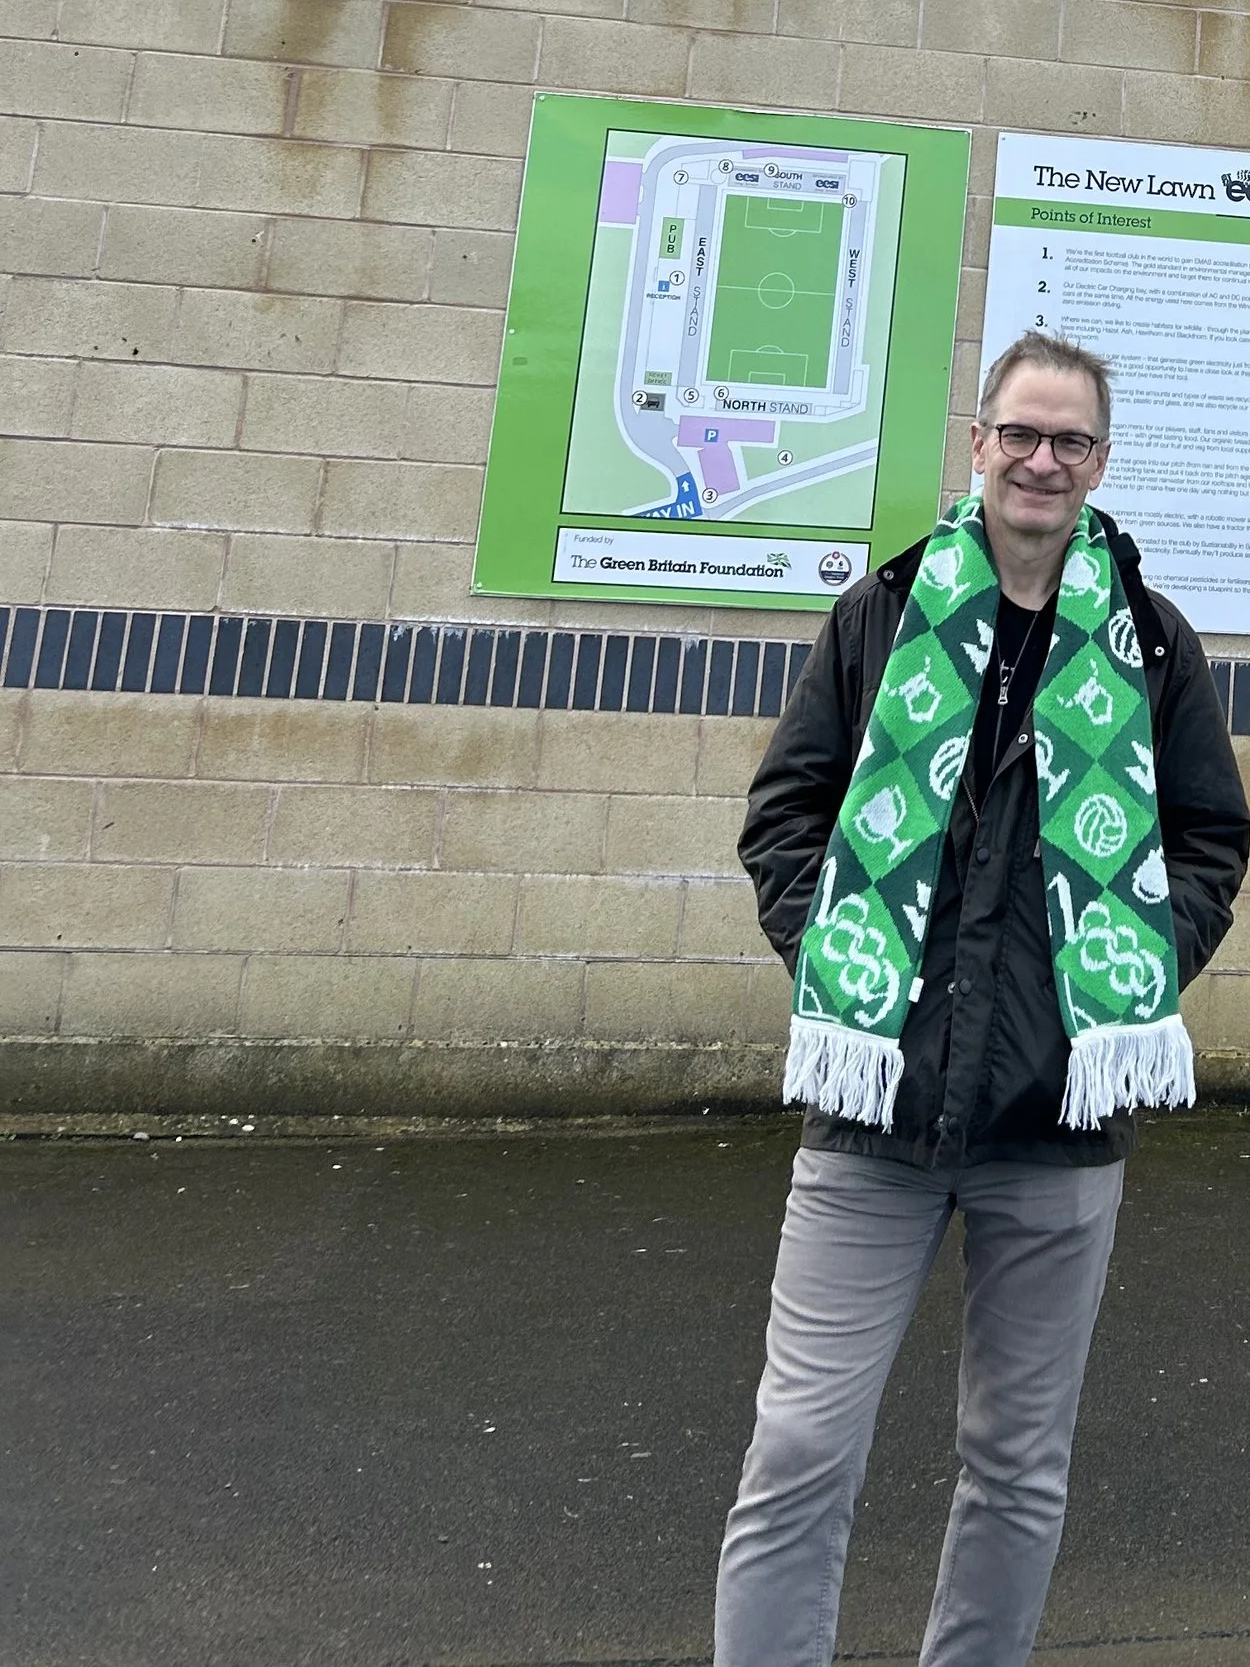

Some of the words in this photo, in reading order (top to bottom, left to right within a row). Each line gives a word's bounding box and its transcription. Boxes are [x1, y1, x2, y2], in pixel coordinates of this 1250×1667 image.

[722, 162, 730, 171] 8
[768, 166, 775, 175] 9
[678, 173, 685, 182] 7
[1034, 165, 1081, 189] The
[1085, 170, 1144, 194] New
[1147, 175, 1216, 200] Lawn
[773, 181, 802, 190] STAND
[845, 196, 855, 206] 10
[1031, 207, 1076, 224] Points
[1080, 211, 1095, 224] of
[1097, 212, 1152, 229] Interest
[667, 225, 677, 254] PUB
[695, 237, 707, 276] EAST
[1042, 247, 1054, 260] 1.
[848, 249, 860, 288] WEST
[1037, 280, 1051, 294] 2.
[688, 286, 701, 336] STAND
[841, 298, 854, 348] STAND
[1035, 314, 1048, 328] 3.
[636, 393, 644, 403] 2
[688, 390, 695, 400] 5
[718, 389, 725, 398] 6
[722, 399, 767, 412] NORTH
[769, 402, 809, 415] STAND
[707, 430, 717, 441] P
[781, 453, 789, 463] 4
[707, 491, 714, 500] 3
[677, 501, 696, 516] IN
[574, 535, 603, 544] Funded
[604, 536, 614, 545] by
[571, 555, 597, 569] The
[600, 557, 645, 572] Green
[648, 559, 697, 574] Britain
[700, 562, 784, 578] Foundation
